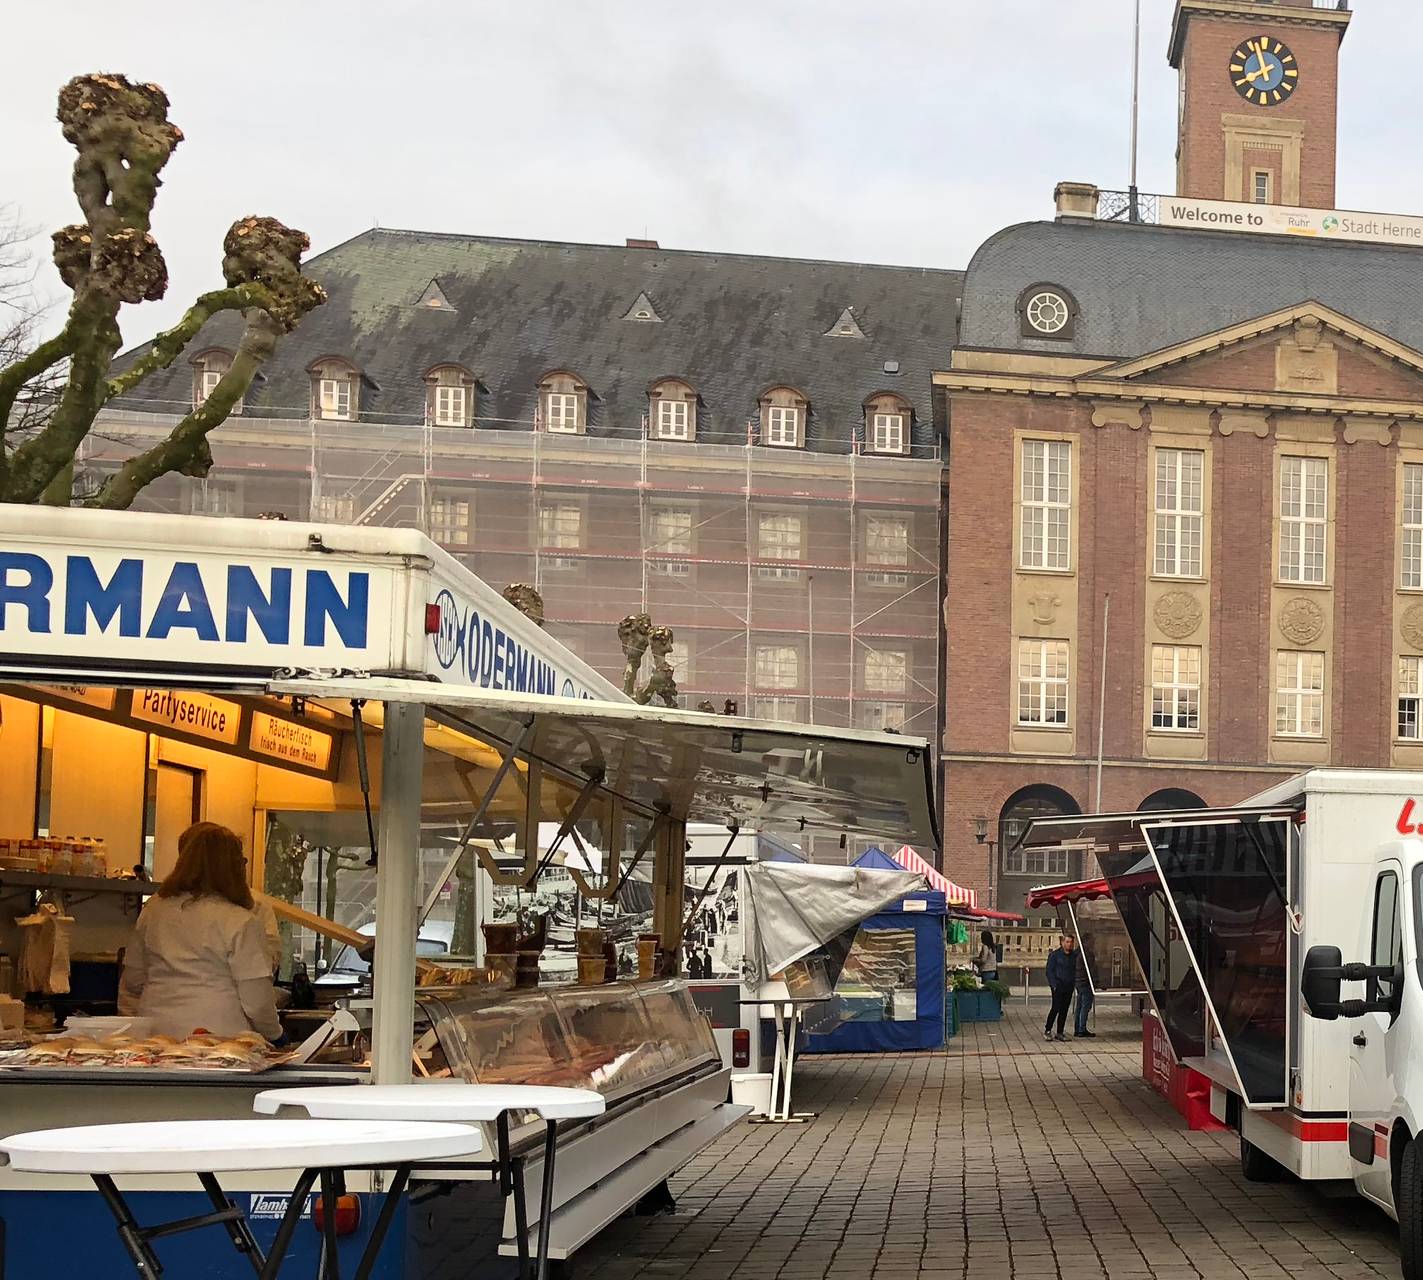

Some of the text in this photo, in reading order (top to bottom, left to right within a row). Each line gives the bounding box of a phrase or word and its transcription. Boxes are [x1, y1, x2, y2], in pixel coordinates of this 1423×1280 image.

[1171, 205, 1264, 227] Welcome to
[1288, 216, 1311, 228] Ruhr
[1341, 218, 1422, 239] Stadt Herne
[0, 552, 370, 650] RMANN
[143, 688, 226, 733] Partyservice
[278, 743, 288, 756] aus
[289, 745, 300, 758] dem
